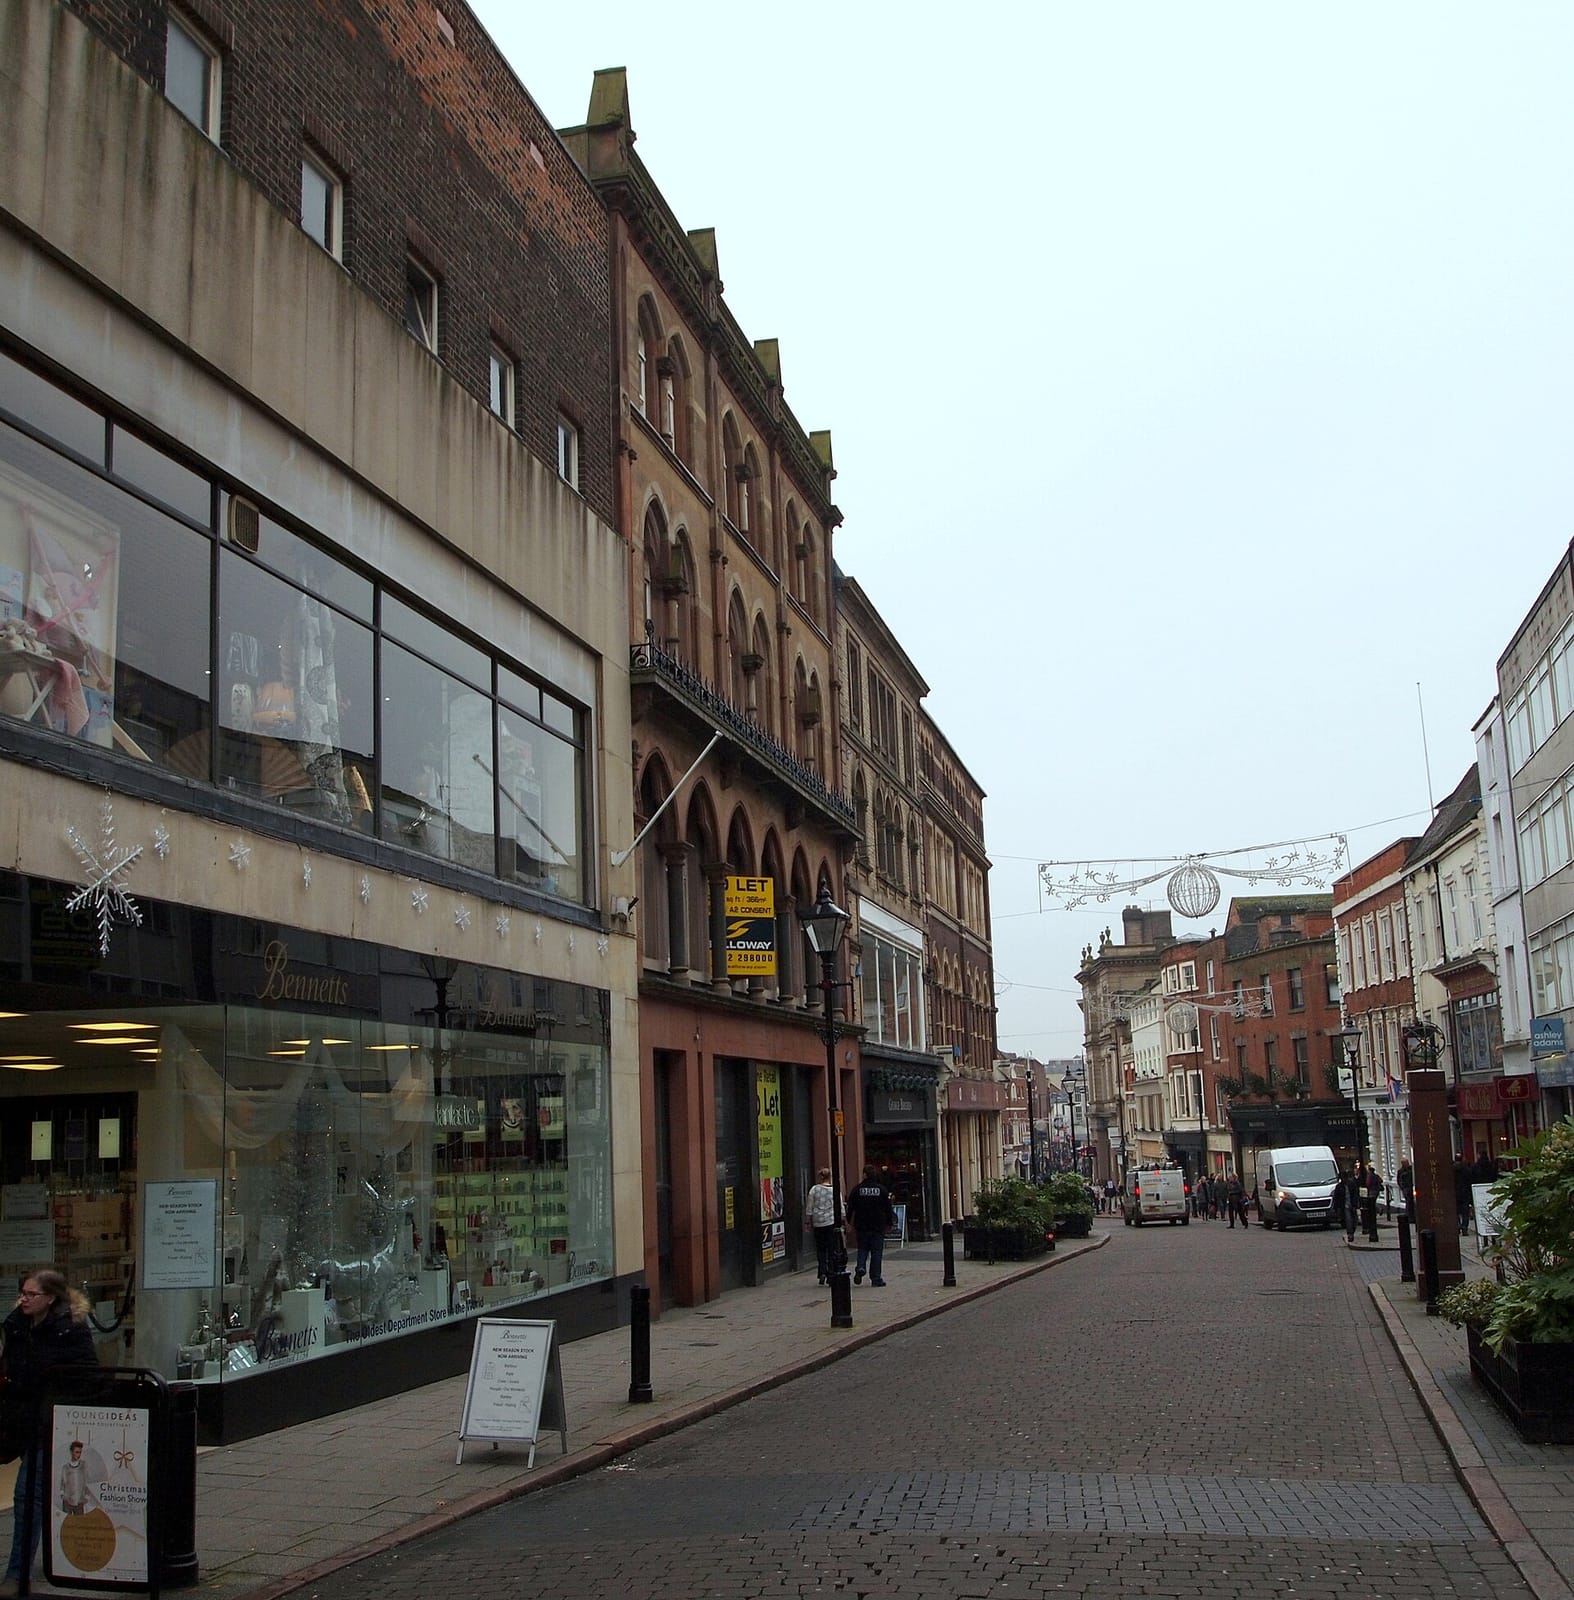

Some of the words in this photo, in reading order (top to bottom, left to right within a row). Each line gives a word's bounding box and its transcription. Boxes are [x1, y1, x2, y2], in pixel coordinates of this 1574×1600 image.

[736, 879, 769, 892] LET
[741, 906, 772, 914] CONSENT
[726, 940, 772, 950] LOWAY
[738, 954, 773, 962] 298000
[256, 940, 349, 1005] Bennetts
[1534, 1031, 1562, 1040] ashley
[1533, 1039, 1564, 1047] adams
[763, 1087, 780, 1116] Let
[361, 1323, 387, 1339] Oldest
[388, 1312, 428, 1333] Department
[430, 1308, 447, 1322] Store
[455, 1302, 466, 1315] the
[99, 1482, 147, 1494] Christmas
[99, 1492, 126, 1502] Fashion
[127, 1495, 147, 1503] Show
